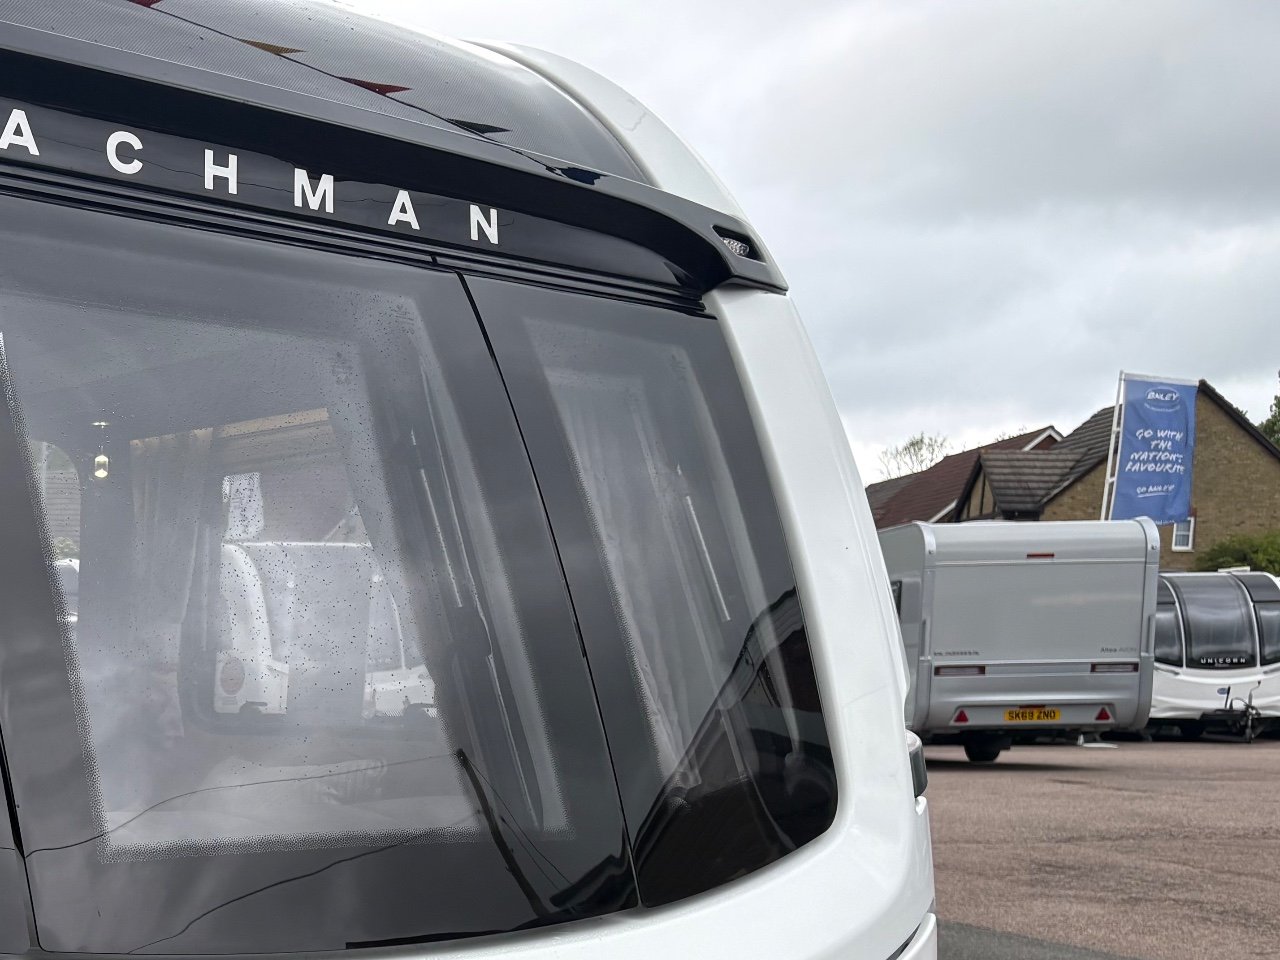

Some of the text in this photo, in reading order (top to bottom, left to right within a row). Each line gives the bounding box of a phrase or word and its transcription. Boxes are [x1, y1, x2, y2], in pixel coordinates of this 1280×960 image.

[1136, 429, 1184, 441] GO WITH
[1150, 439, 1172, 450] THE
